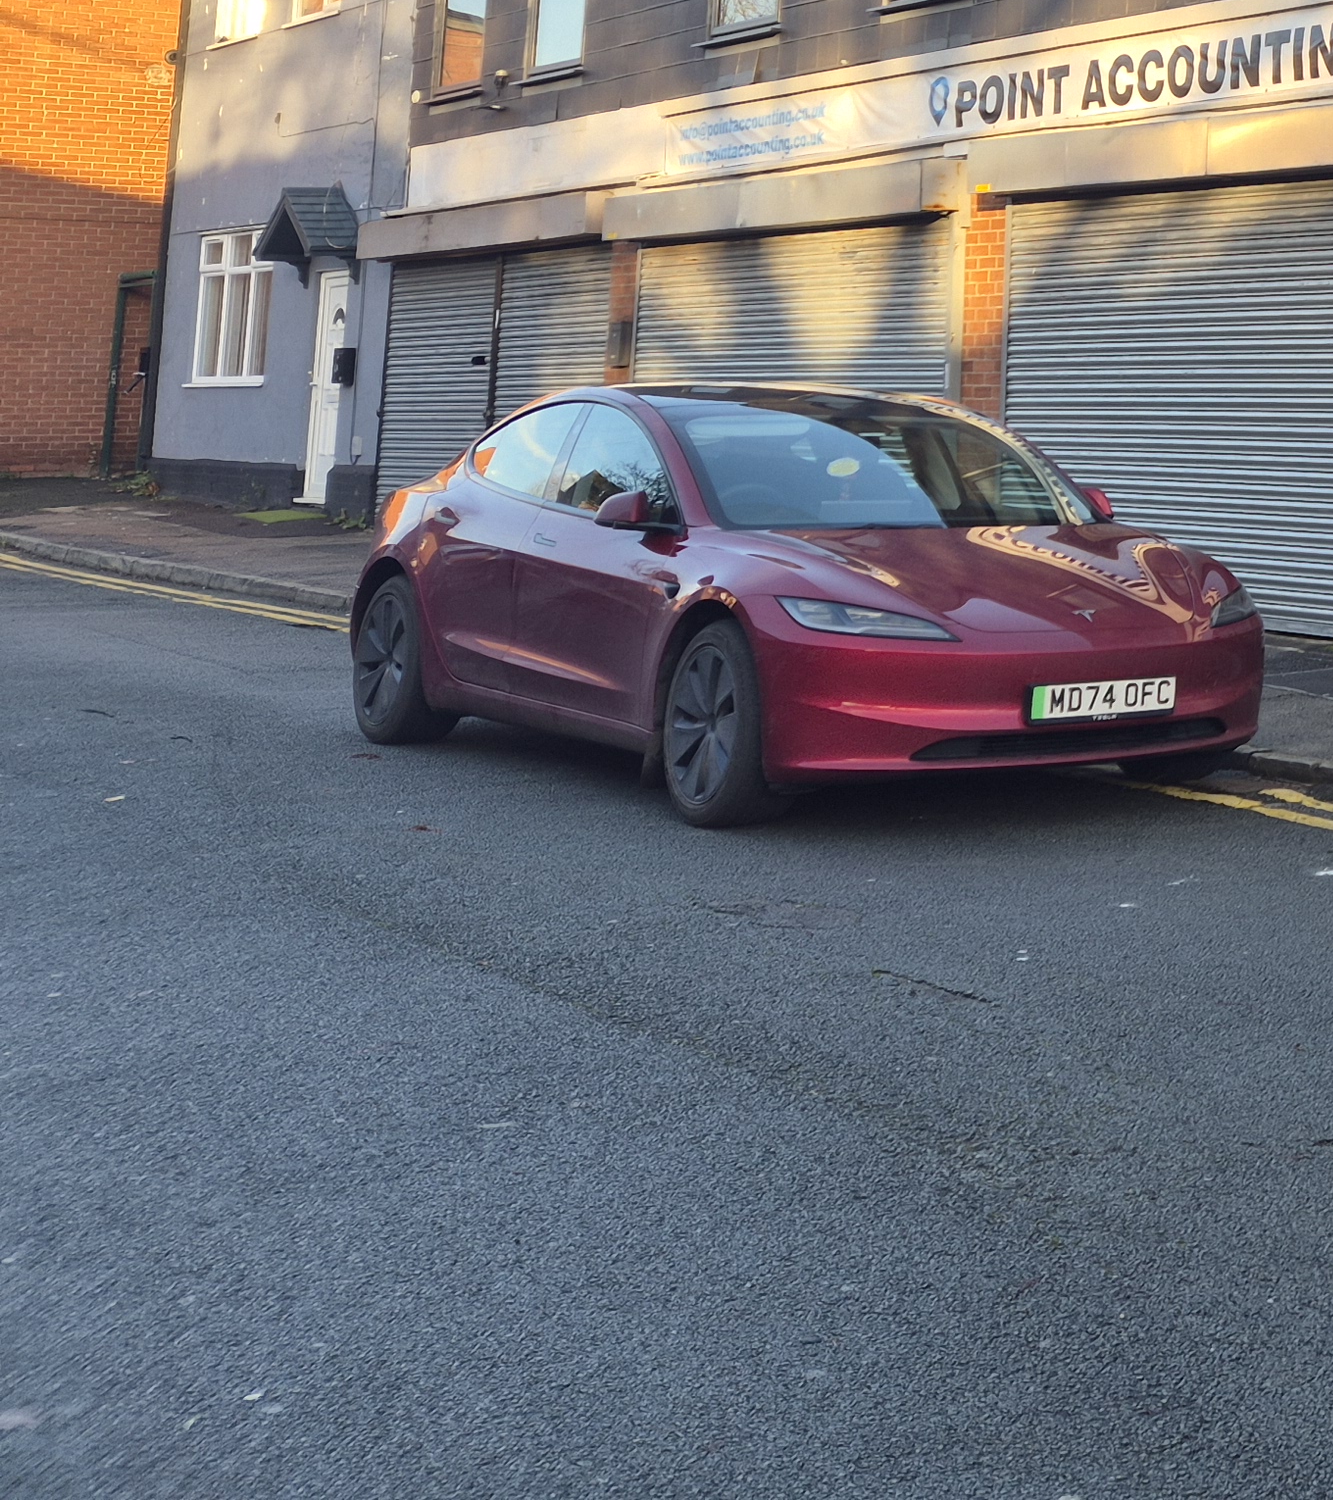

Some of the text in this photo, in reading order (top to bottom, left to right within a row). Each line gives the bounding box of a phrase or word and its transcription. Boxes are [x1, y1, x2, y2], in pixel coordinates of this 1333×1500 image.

[955, 64, 1070, 128] POINT
[680, 102, 826, 141] info@pointaccounting.co.uk
[679, 130, 825, 165] www.pointaccounting.co.uk
[1049, 679, 1171, 714] MD74 OFC
